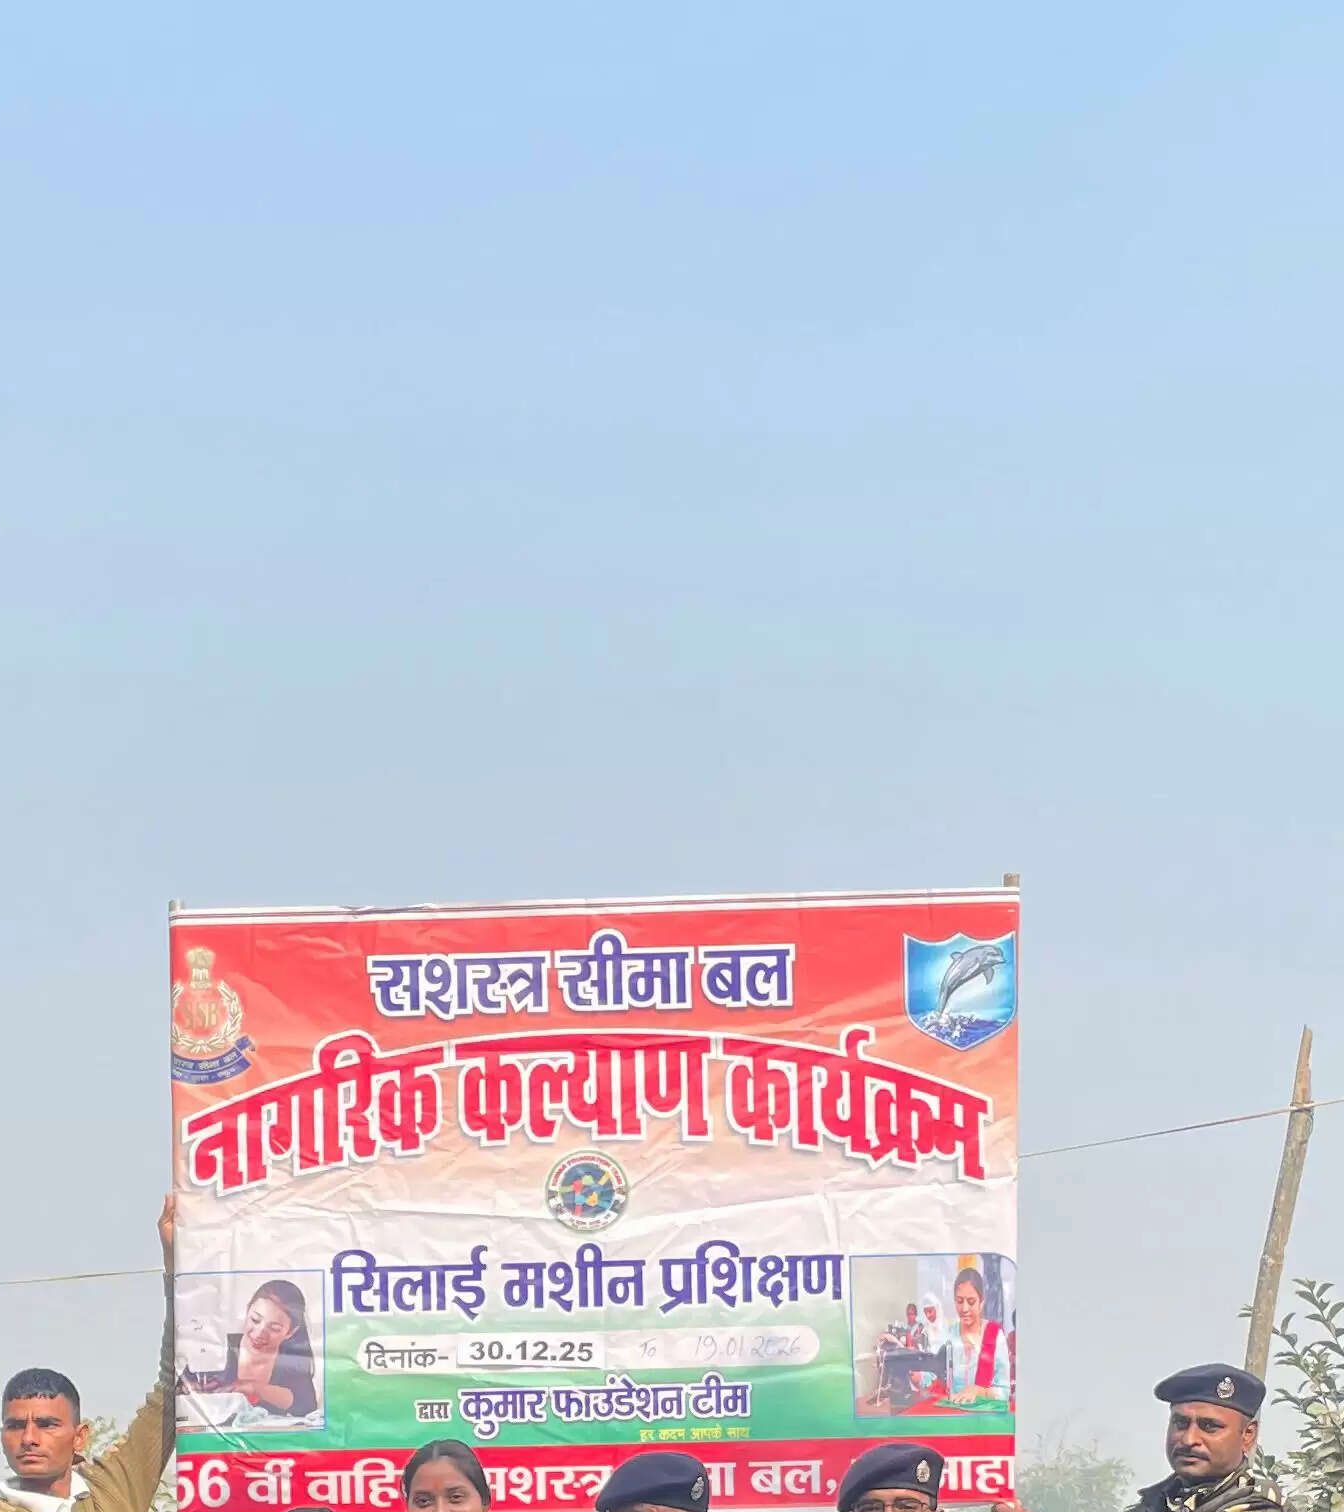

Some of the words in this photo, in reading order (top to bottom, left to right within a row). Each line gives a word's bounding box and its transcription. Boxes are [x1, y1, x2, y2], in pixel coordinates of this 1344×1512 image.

[372, 956, 545, 1013] सशस्त्र
[561, 932, 689, 1008] सीमा
[705, 950, 790, 1006] बल
[189, 1042, 443, 1187] नागरिक
[462, 1035, 709, 1140] कल्याण
[722, 1030, 988, 1179] कार्यक्रम
[331, 1245, 488, 1320] सिलाई
[501, 1243, 645, 1309] मशीन
[659, 1240, 844, 1314] प्रशिक्षण
[469, 1340, 593, 1361] 30.12.25
[417, 1402, 450, 1420] द्वारा
[461, 1390, 546, 1435] कुमार
[552, 1376, 684, 1420] फाउंडेशन
[689, 1374, 750, 1415] टीम
[176, 1459, 231, 1510] 56
